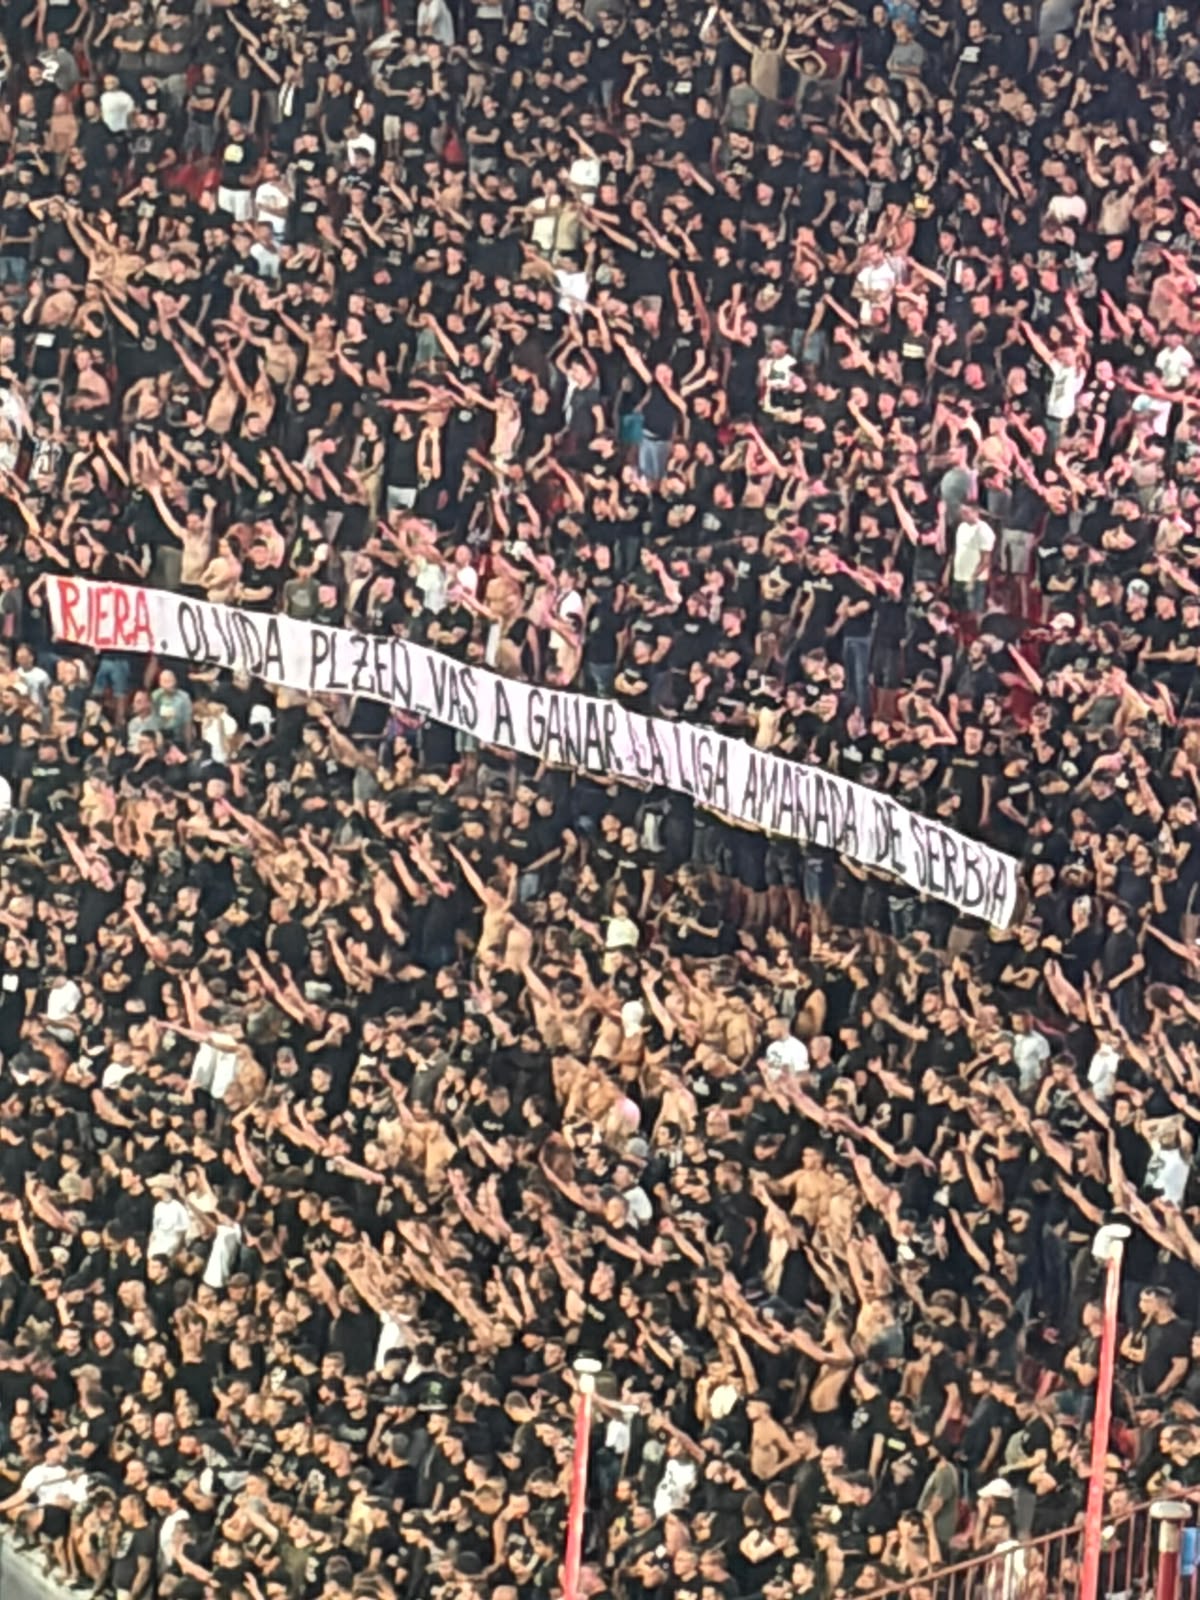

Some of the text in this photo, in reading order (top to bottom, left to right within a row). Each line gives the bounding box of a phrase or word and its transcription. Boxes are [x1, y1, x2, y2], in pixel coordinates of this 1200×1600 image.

[178, 601, 285, 680] OLVIDA
[426, 655, 479, 730] VAS
[493, 680, 516, 746] A
[527, 689, 623, 772] GANAR
[672, 724, 731, 812] LIGA
[740, 752, 859, 857] AMAÑADA
[871, 798, 908, 873] DE
[909, 815, 1008, 924] SERBIA
